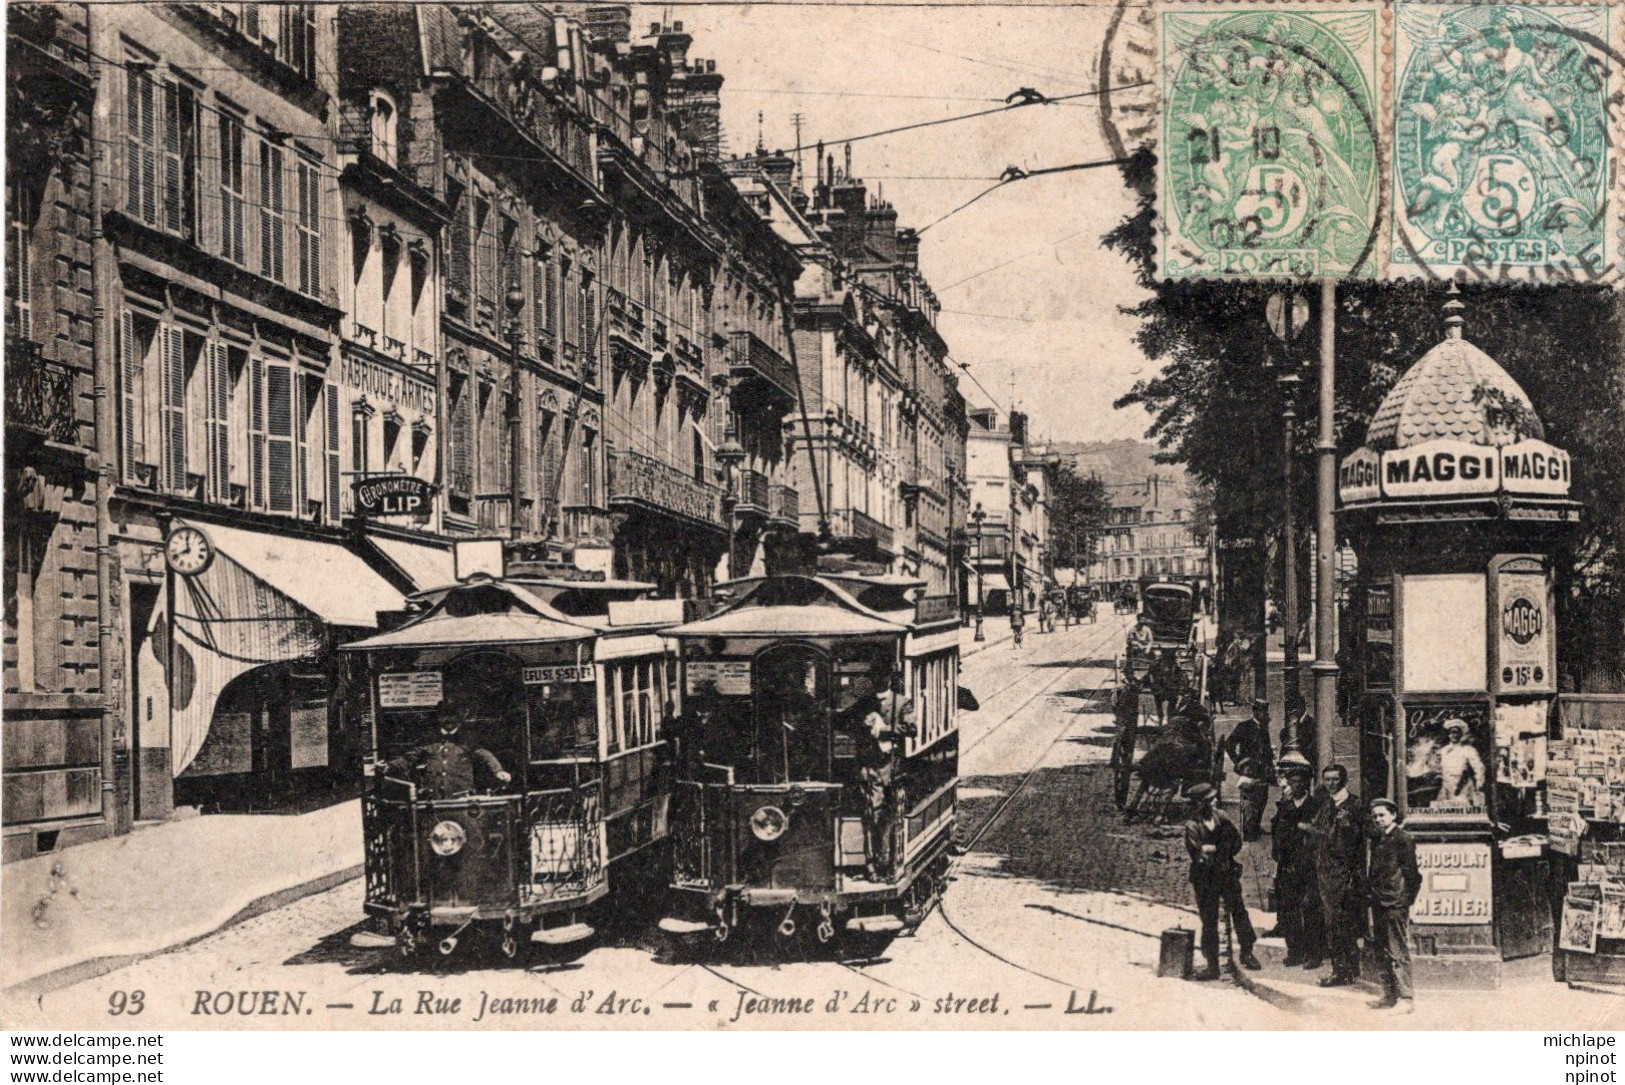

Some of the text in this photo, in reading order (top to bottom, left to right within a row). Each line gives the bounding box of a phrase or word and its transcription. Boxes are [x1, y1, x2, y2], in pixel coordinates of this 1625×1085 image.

[1225, 251, 1317, 275] POSTES
[1453, 240, 1544, 264] POSTES
[340, 356, 394, 402] FABRIQUE
[1340, 458, 1378, 488] MAGGI
[1386, 453, 1493, 484] MAGGI
[1504, 453, 1568, 483] MAGGI
[383, 496, 421, 513] LIP
[1504, 606, 1541, 636] MAGGI
[1416, 851, 1488, 869] CHOCOLAT
[1414, 898, 1488, 917] MENIER
